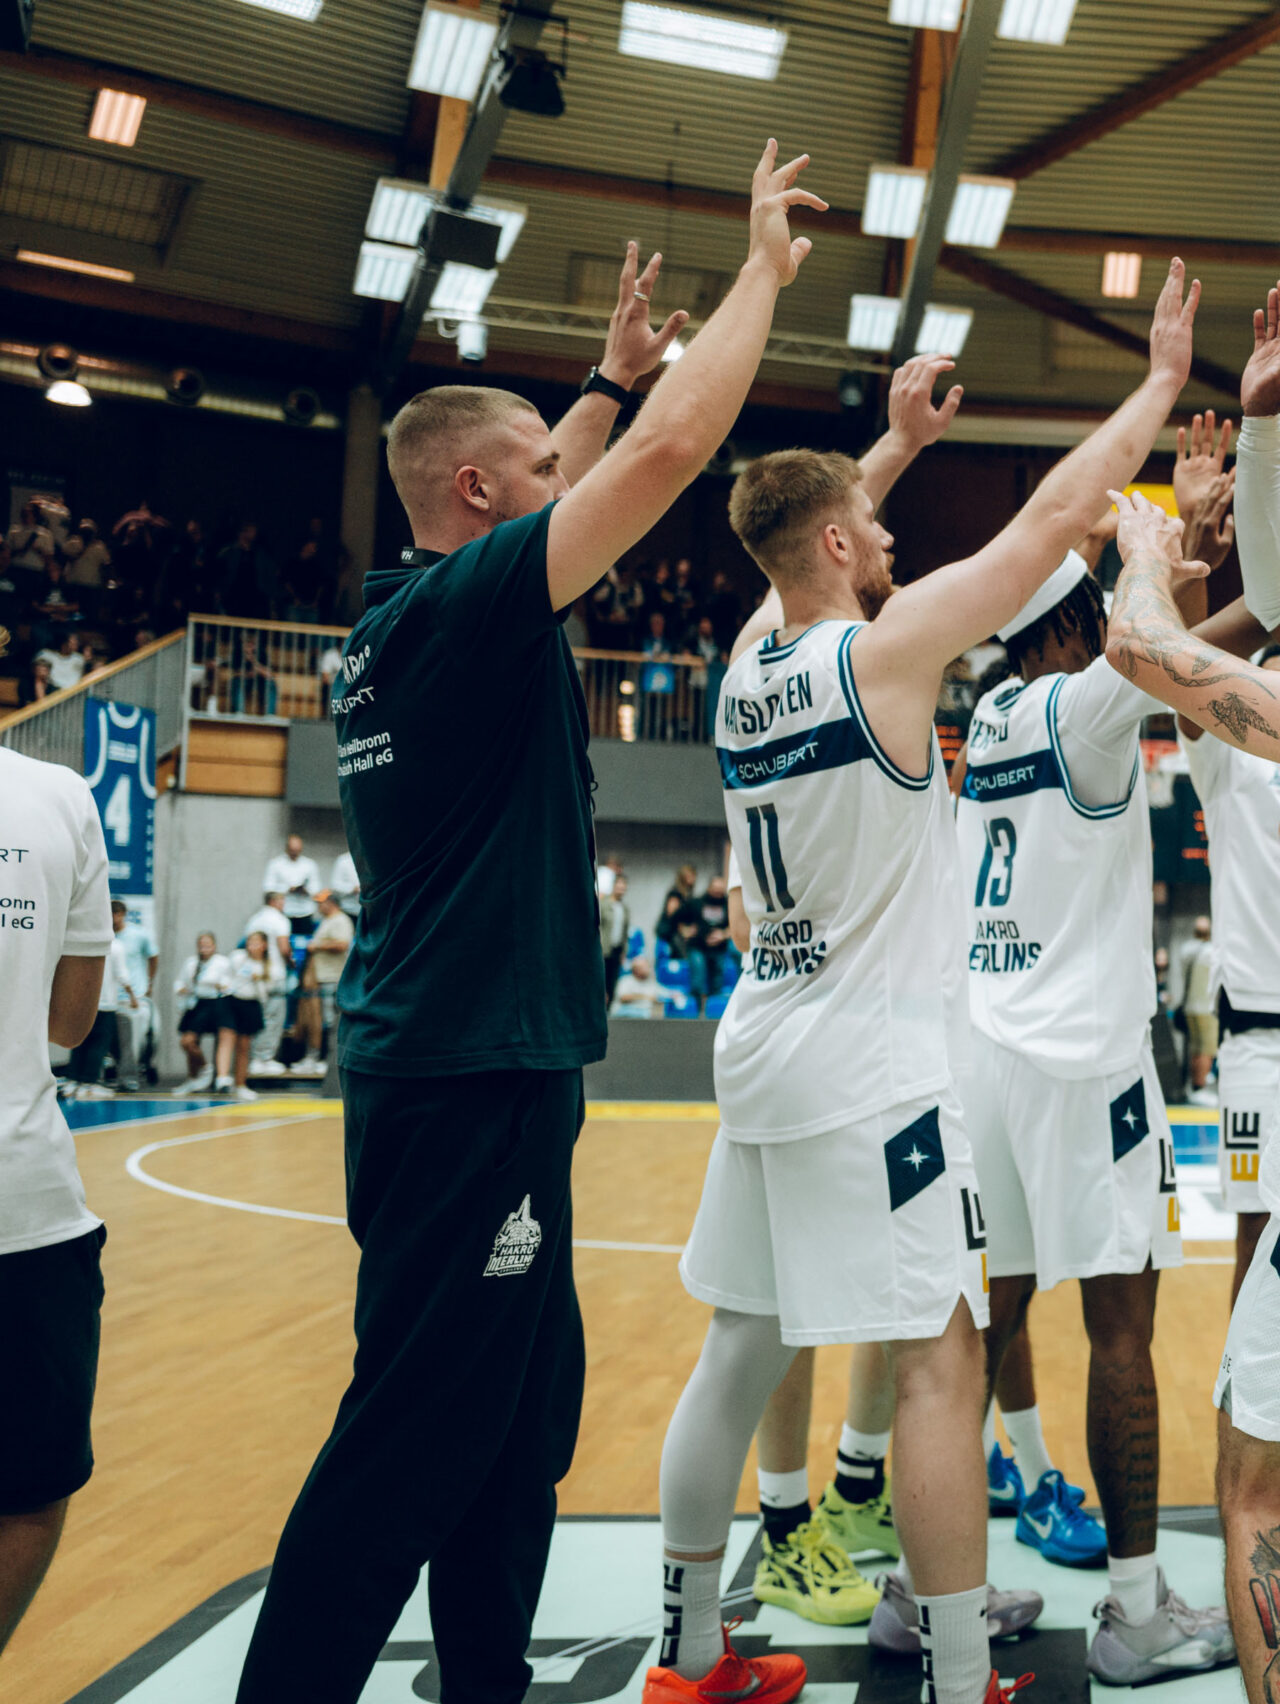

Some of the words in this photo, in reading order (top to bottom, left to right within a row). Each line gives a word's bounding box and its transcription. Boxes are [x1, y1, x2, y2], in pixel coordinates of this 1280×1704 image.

[353, 753, 374, 774] Hall
[375, 747, 393, 766] eG
[738, 741, 819, 780] SCHUBERT
[974, 765, 1036, 792] CHUBERT
[104, 773, 132, 847] 4
[745, 802, 796, 913] 11
[974, 817, 1017, 908] 13
[976, 920, 1020, 940] AKRO
[968, 942, 1042, 973] ERLINS
[500, 1243, 534, 1256] HAKRO
